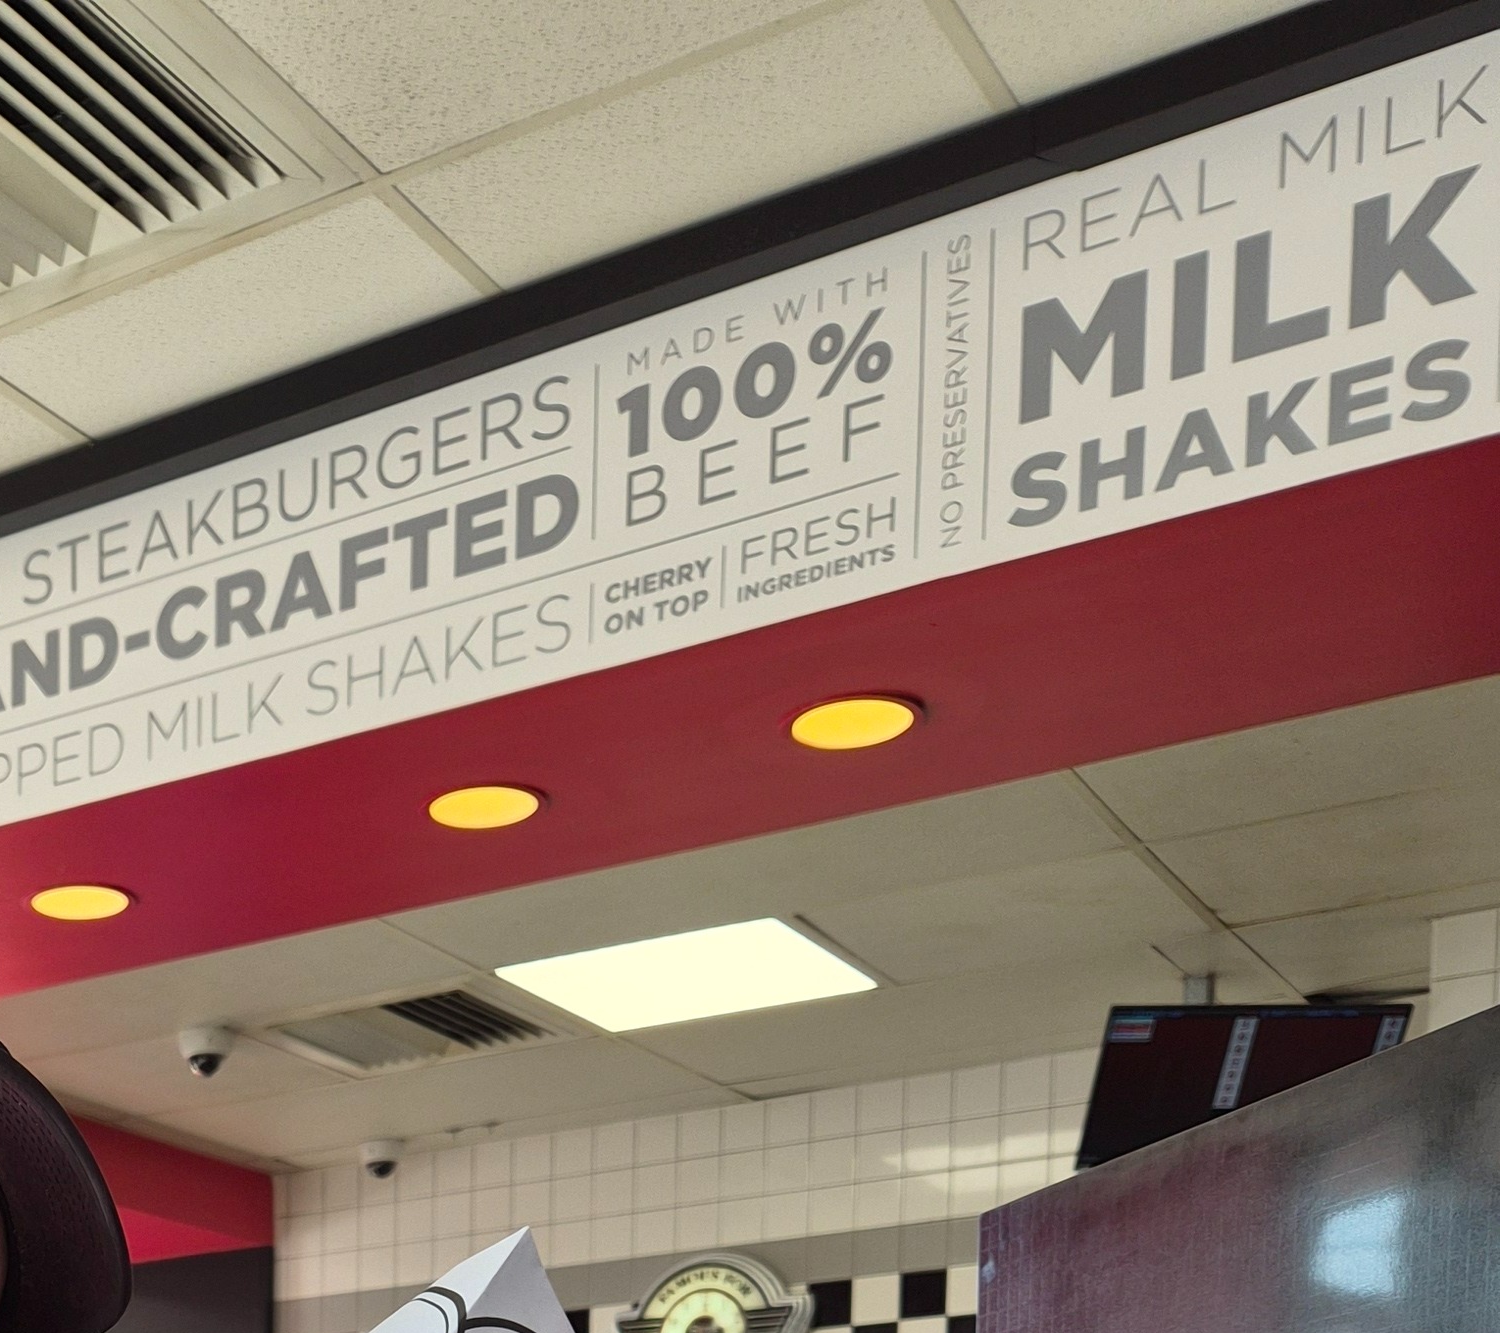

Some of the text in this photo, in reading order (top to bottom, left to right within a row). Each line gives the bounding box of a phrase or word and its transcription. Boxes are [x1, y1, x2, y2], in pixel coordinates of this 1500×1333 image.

[1022, 64, 1488, 271] REAL MILK
[626, 266, 889, 376] MADE WITH
[1018, 163, 1482, 425] MILK
[616, 307, 893, 458] 100%
[939, 233, 973, 549] NO PRESERVATIVES
[1007, 338, 1472, 528] SHAKES
[22, 375, 572, 606] STEAKBURGERS
[625, 393, 885, 527] BEEF
[740, 496, 897, 575] FRESH
[604, 556, 713, 604] CHERRY
[604, 589, 710, 636] ON TOP
[737, 544, 896, 603] INGREDIENTS
[147, 673, 285, 762] MILK
[306, 594, 572, 716] SHAKES
